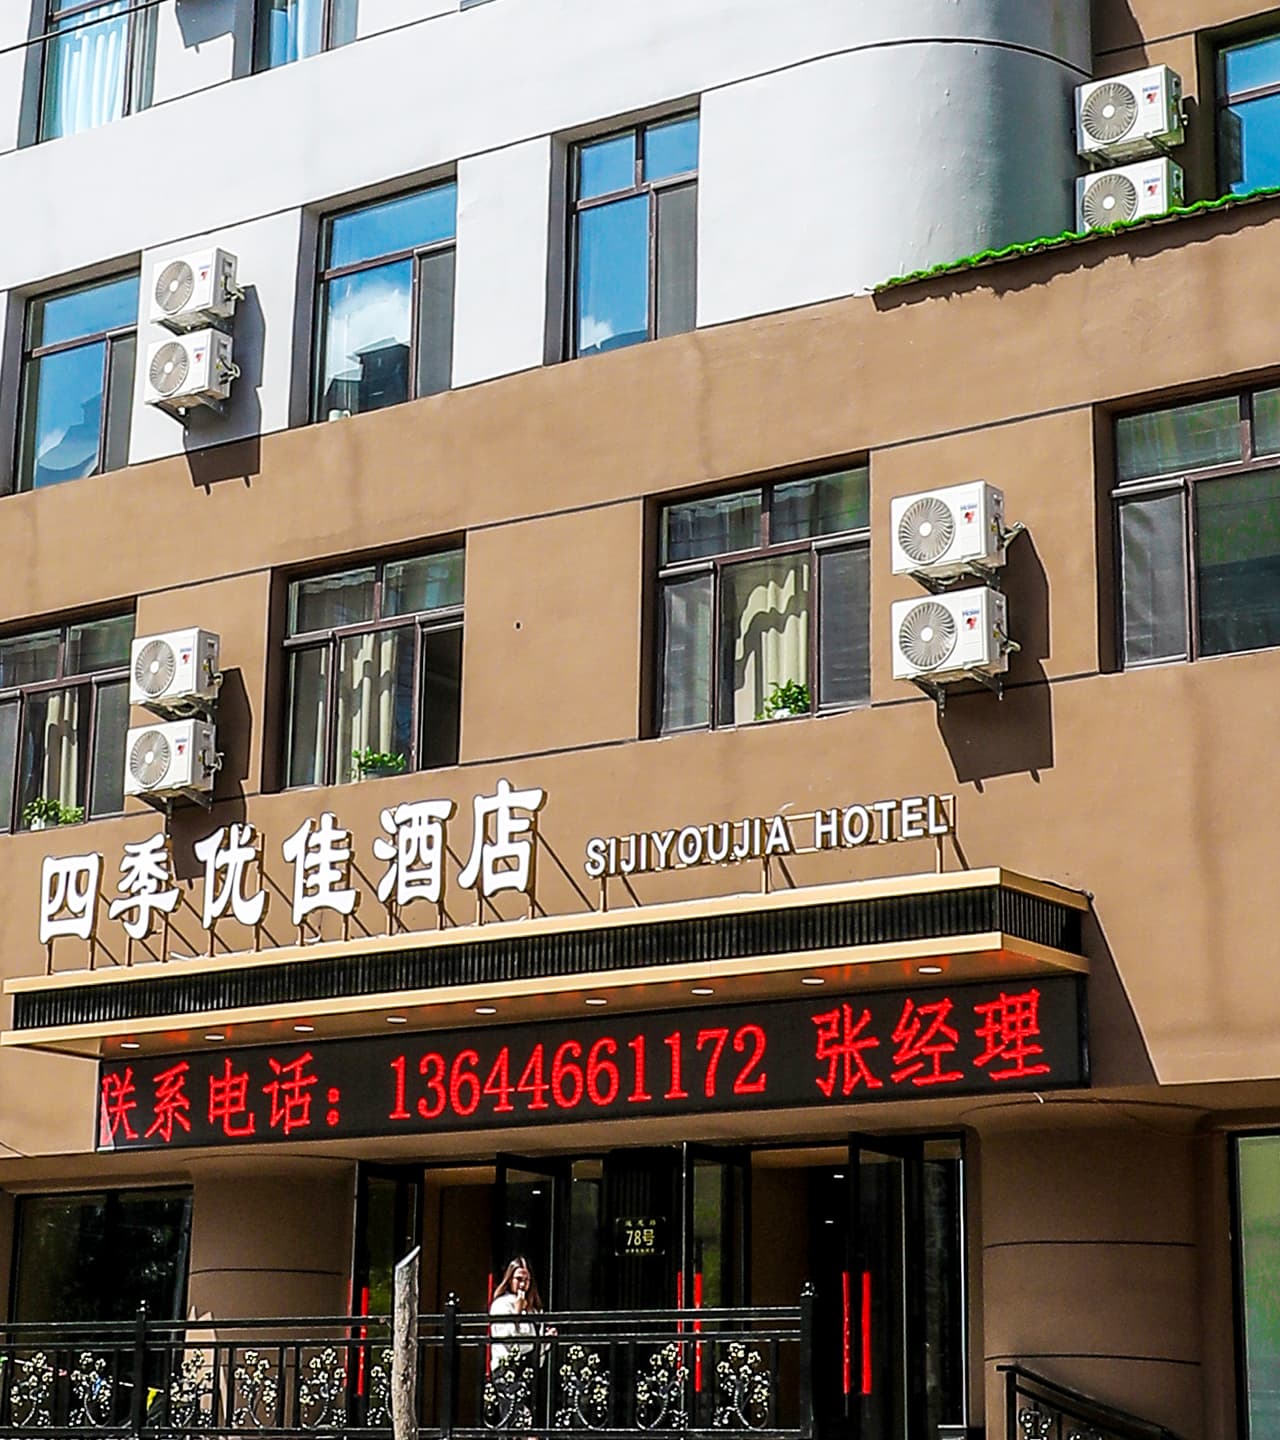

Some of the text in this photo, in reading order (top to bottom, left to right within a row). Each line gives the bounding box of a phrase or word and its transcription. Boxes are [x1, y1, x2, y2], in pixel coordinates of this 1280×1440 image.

[39, 778, 546, 945] 四季优佳酒店
[585, 794, 949, 877] SIJIYOUJIA HOTEL
[388, 1024, 767, 1119] 13644661172
[811, 988, 1051, 1096] 张经理
[625, 1228, 656, 1247] 78号
